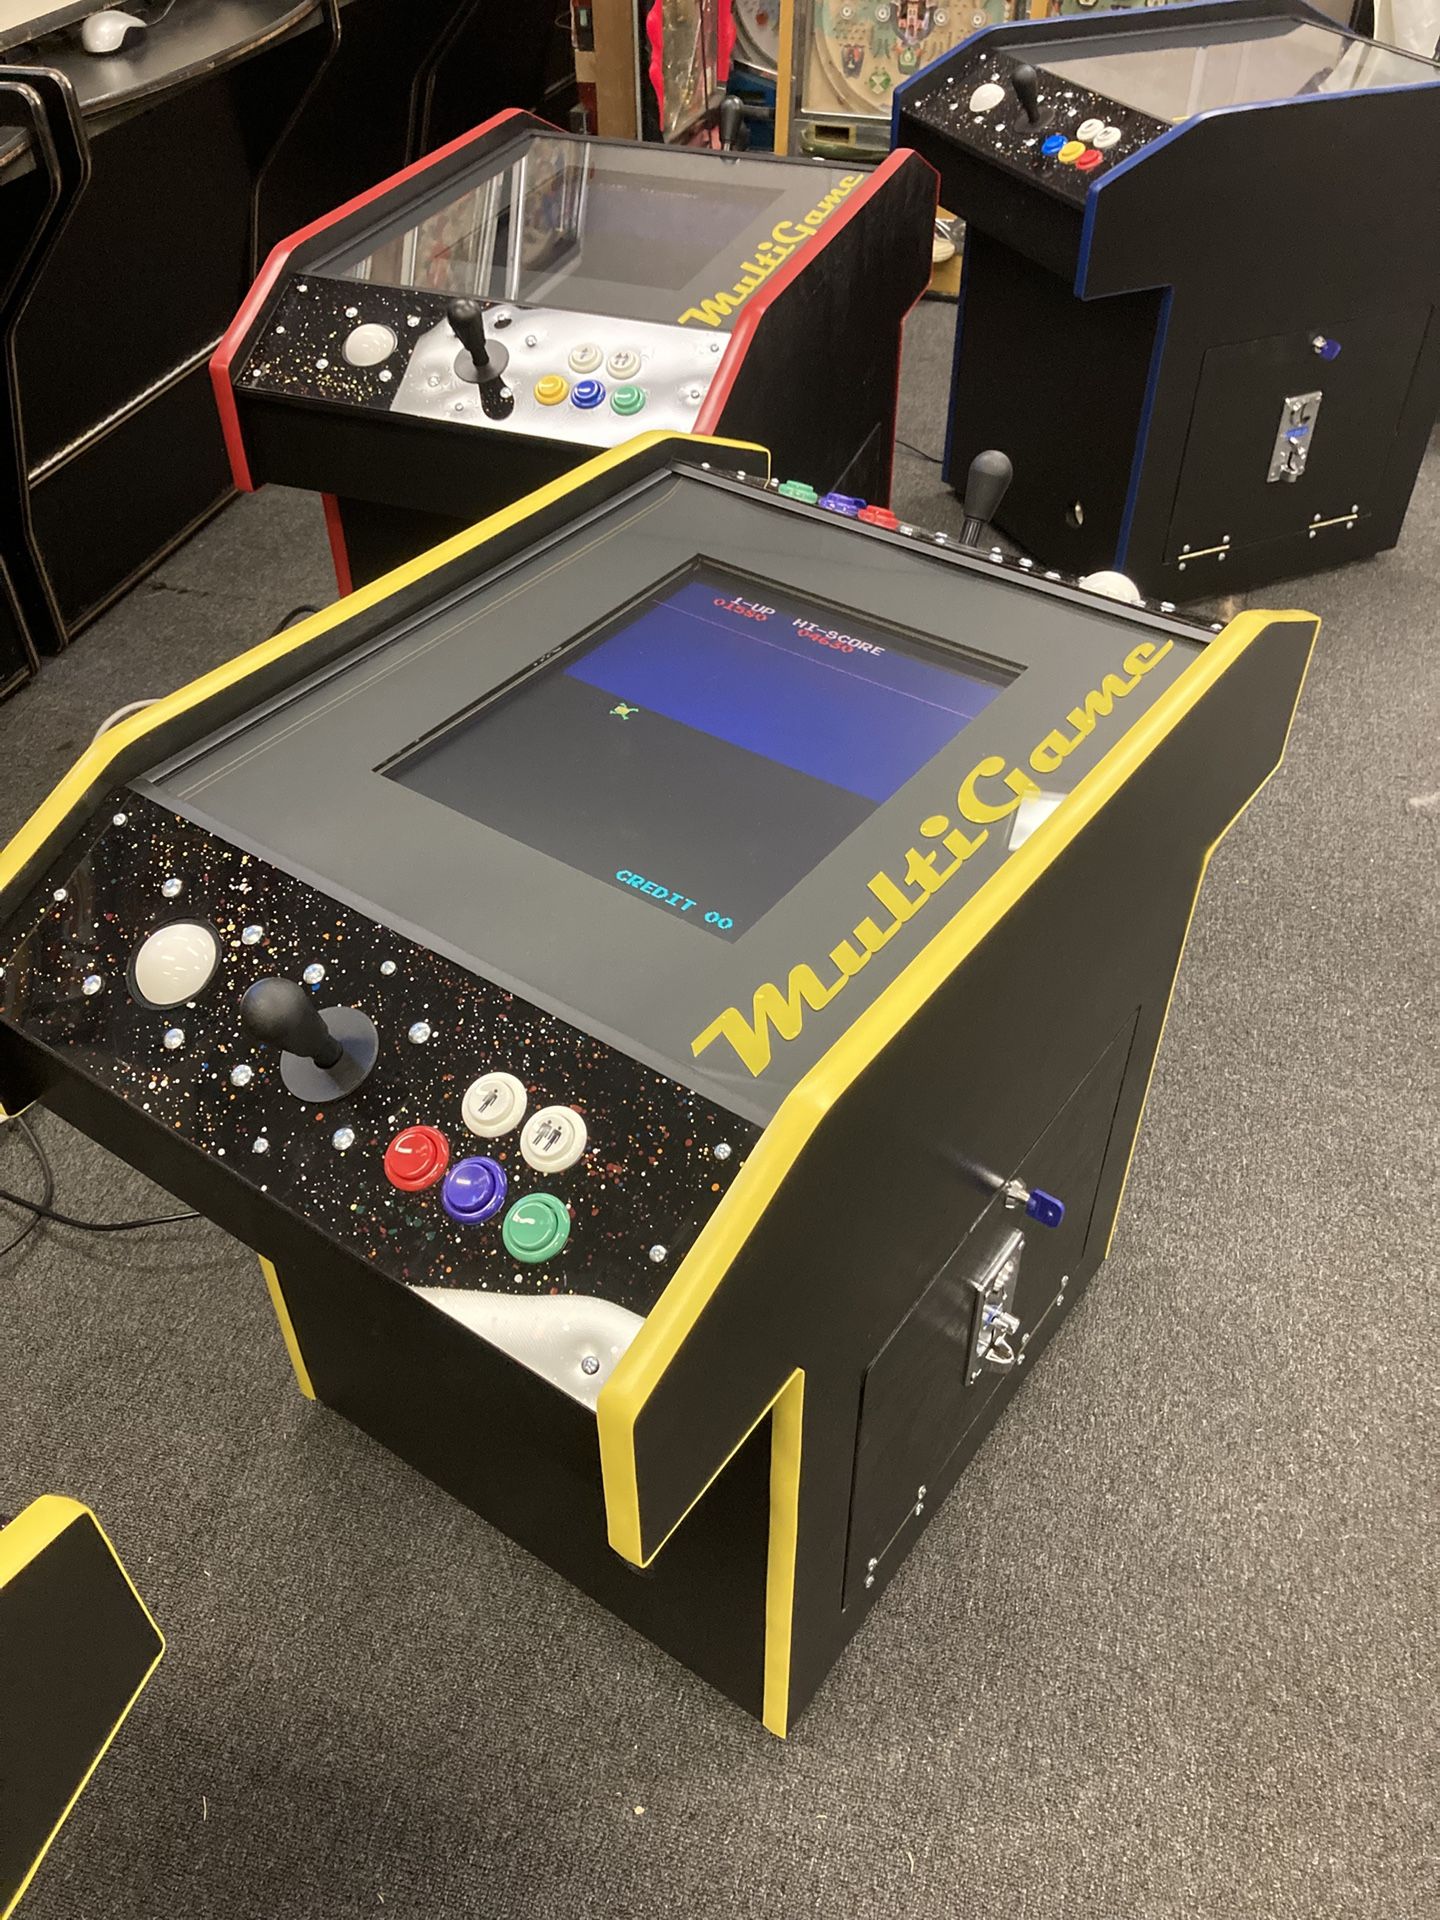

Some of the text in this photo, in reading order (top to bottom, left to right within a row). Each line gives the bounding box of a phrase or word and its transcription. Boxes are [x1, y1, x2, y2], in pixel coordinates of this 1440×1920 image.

[678, 174, 864, 327] MultiGame
[730, 597, 885, 656] 1-UP HI-SCORE
[616, 870, 733, 929] CREDIT 00
[691, 639, 1174, 1077] MultiGame
